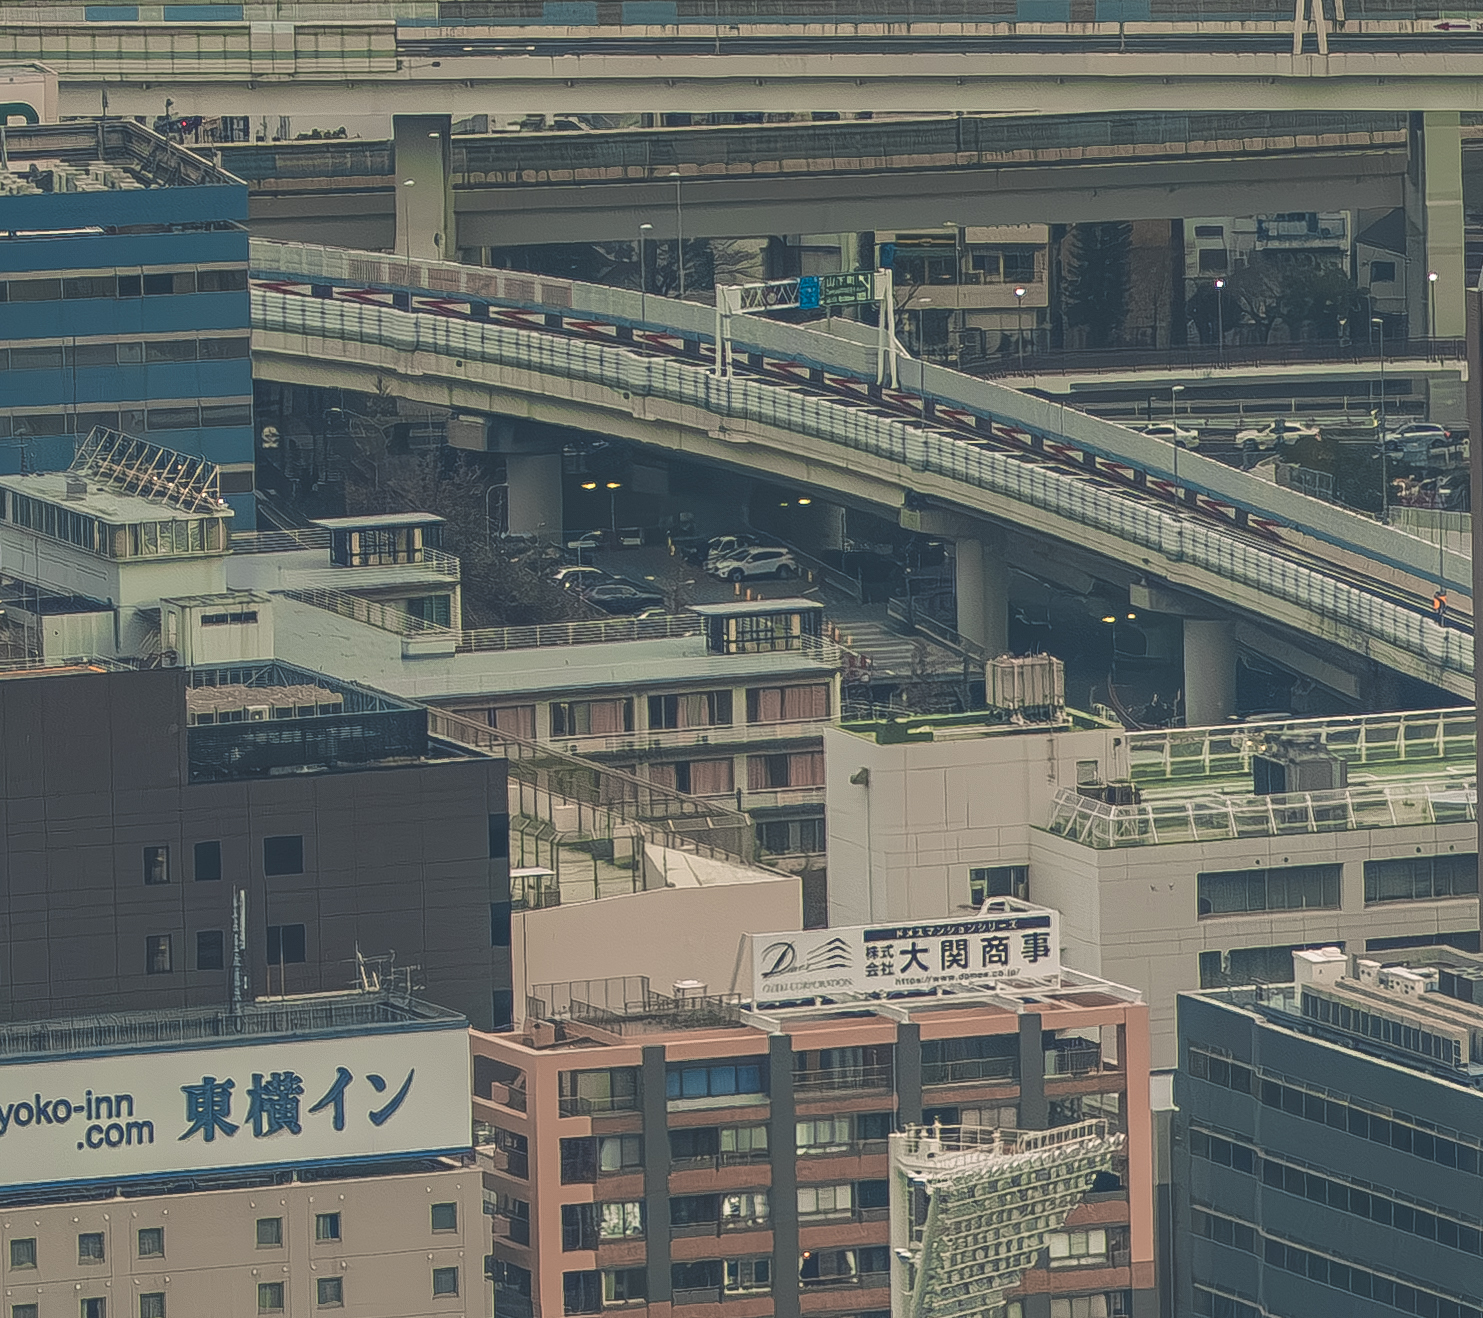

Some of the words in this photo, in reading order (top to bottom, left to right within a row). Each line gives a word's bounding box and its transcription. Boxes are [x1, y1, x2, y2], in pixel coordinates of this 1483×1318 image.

[900, 932, 1050, 973] 大関商事
[177, 1066, 415, 1143] 東横イン
[77, 1118, 154, 1150] .com
